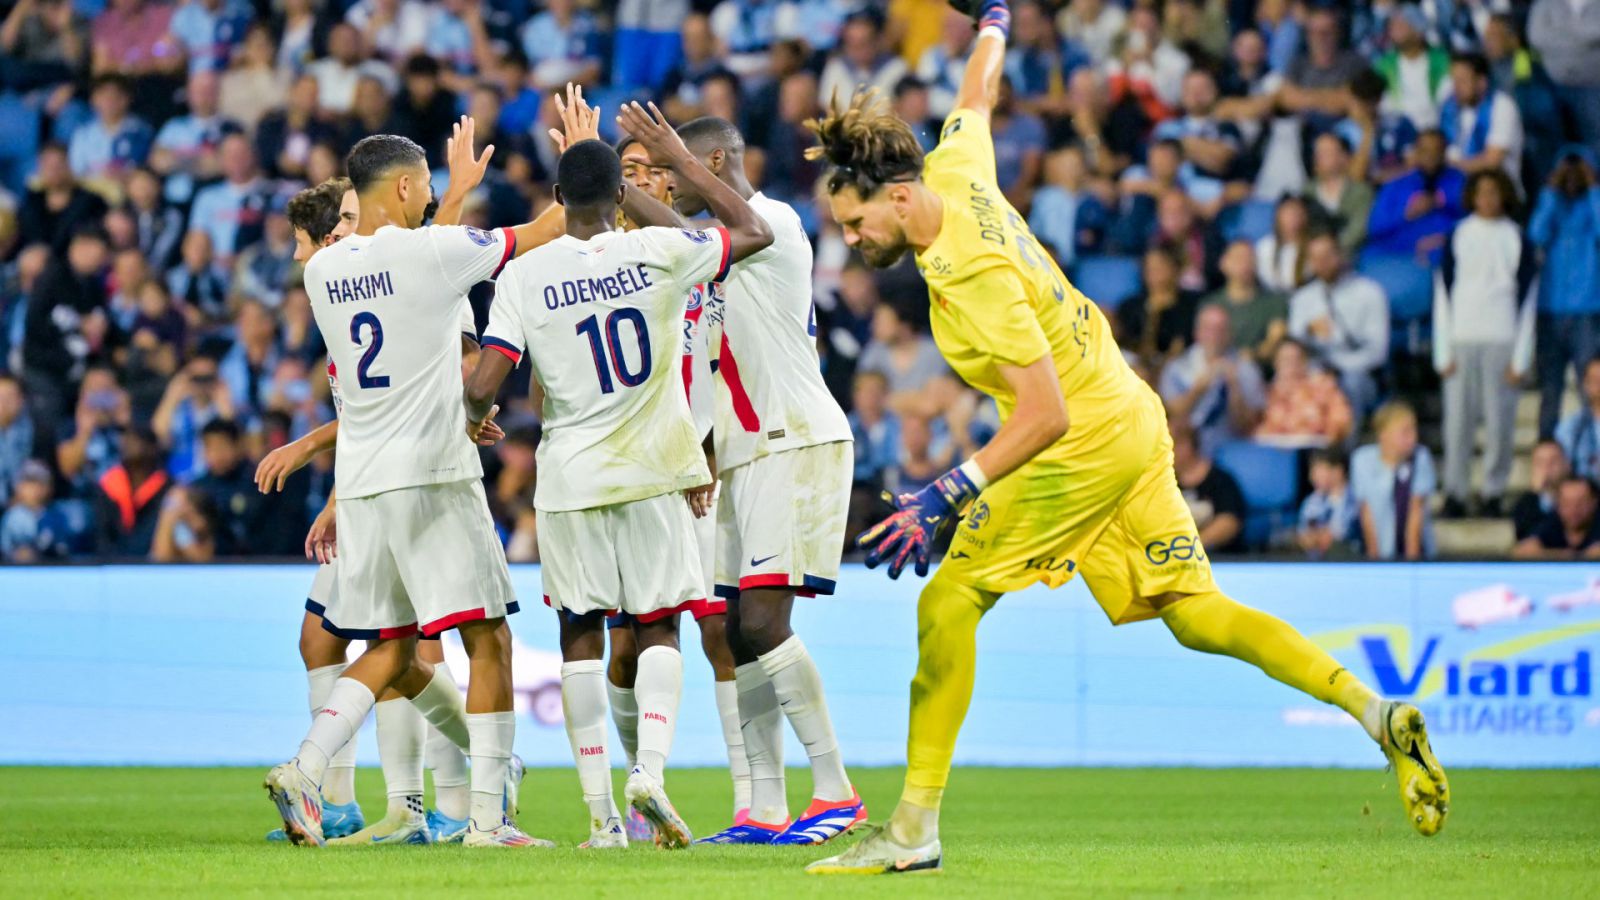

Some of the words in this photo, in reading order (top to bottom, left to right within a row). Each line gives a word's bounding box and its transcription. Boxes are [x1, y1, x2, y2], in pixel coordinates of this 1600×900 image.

[326, 271, 394, 304] HAKIMI
[350, 311, 390, 389] 2
[575, 307, 652, 394] 10
[1361, 636, 1592, 696] Viard
[644, 712, 667, 724] PARIS
[580, 746, 604, 756] PARIS
